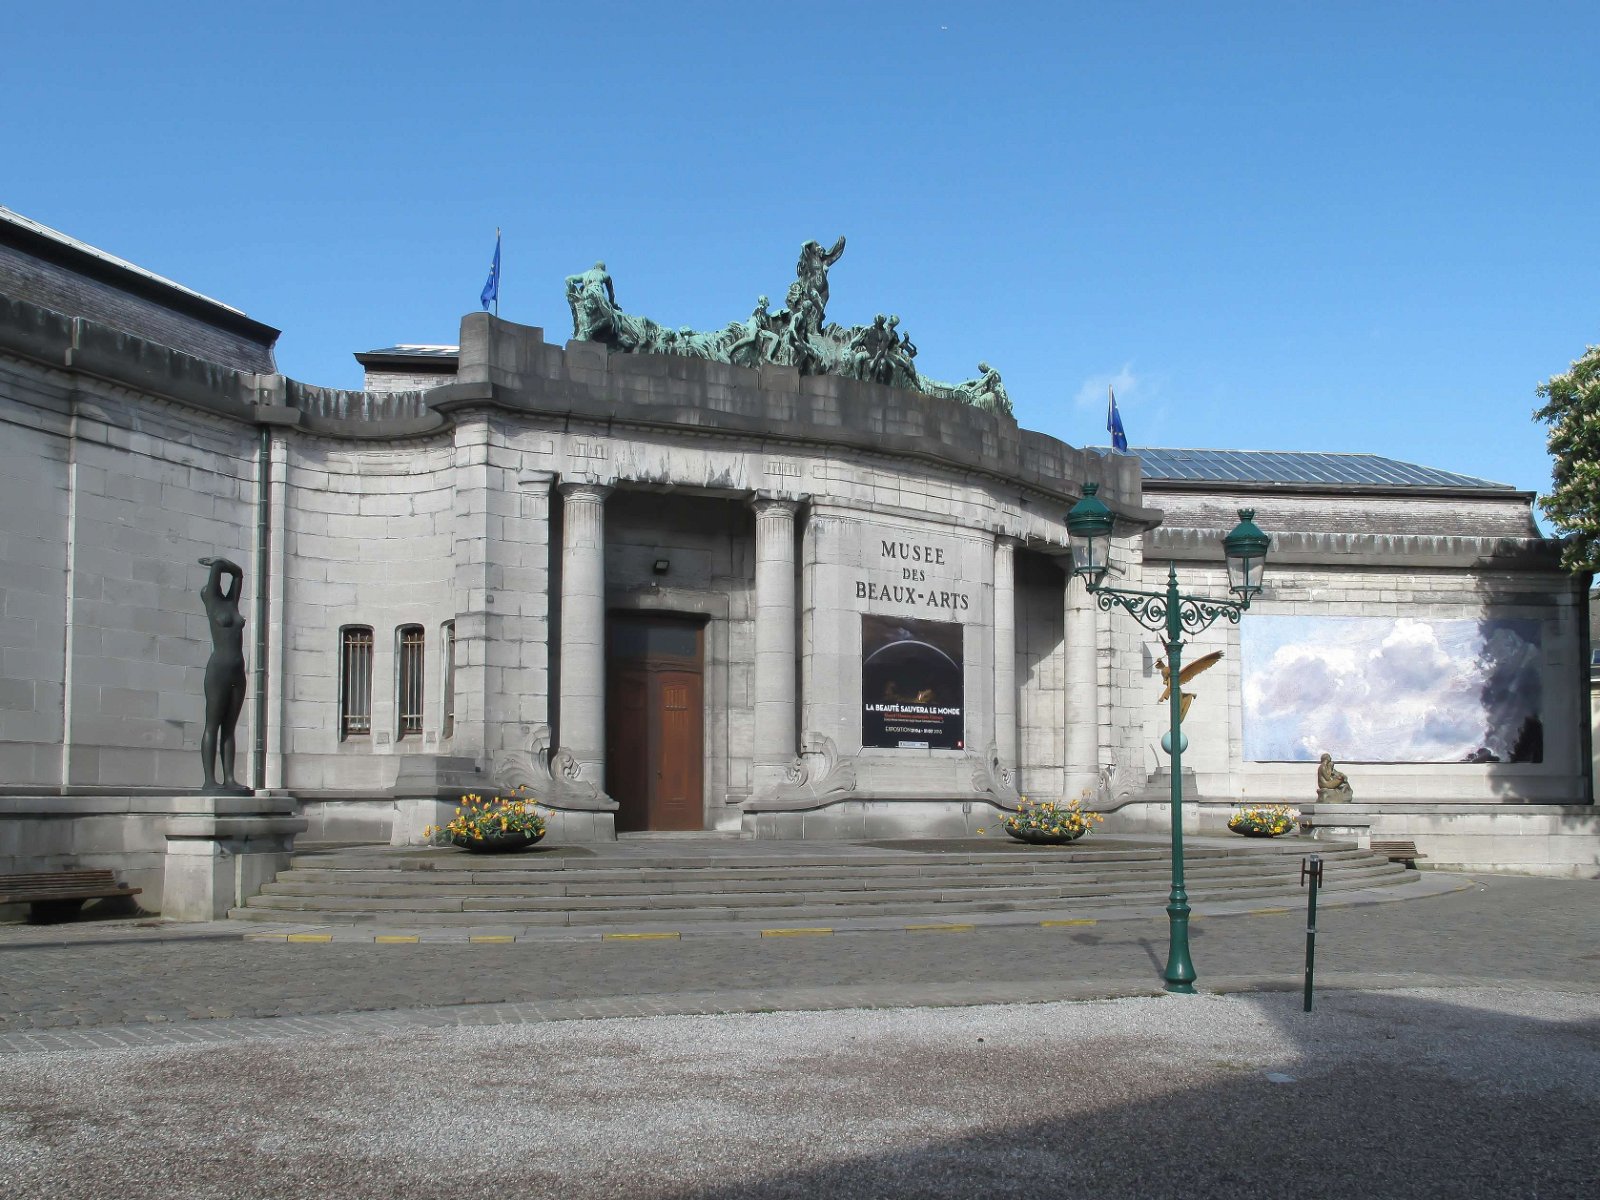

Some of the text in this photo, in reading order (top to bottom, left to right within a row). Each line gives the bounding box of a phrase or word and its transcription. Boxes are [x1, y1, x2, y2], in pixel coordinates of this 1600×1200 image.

[881, 540, 945, 565] MUSEE
[902, 568, 925, 581] DES
[875, 703, 900, 713] BEAUTÉ
[900, 706, 928, 714] SAUVERA
[938, 708, 960, 716] MONDE
